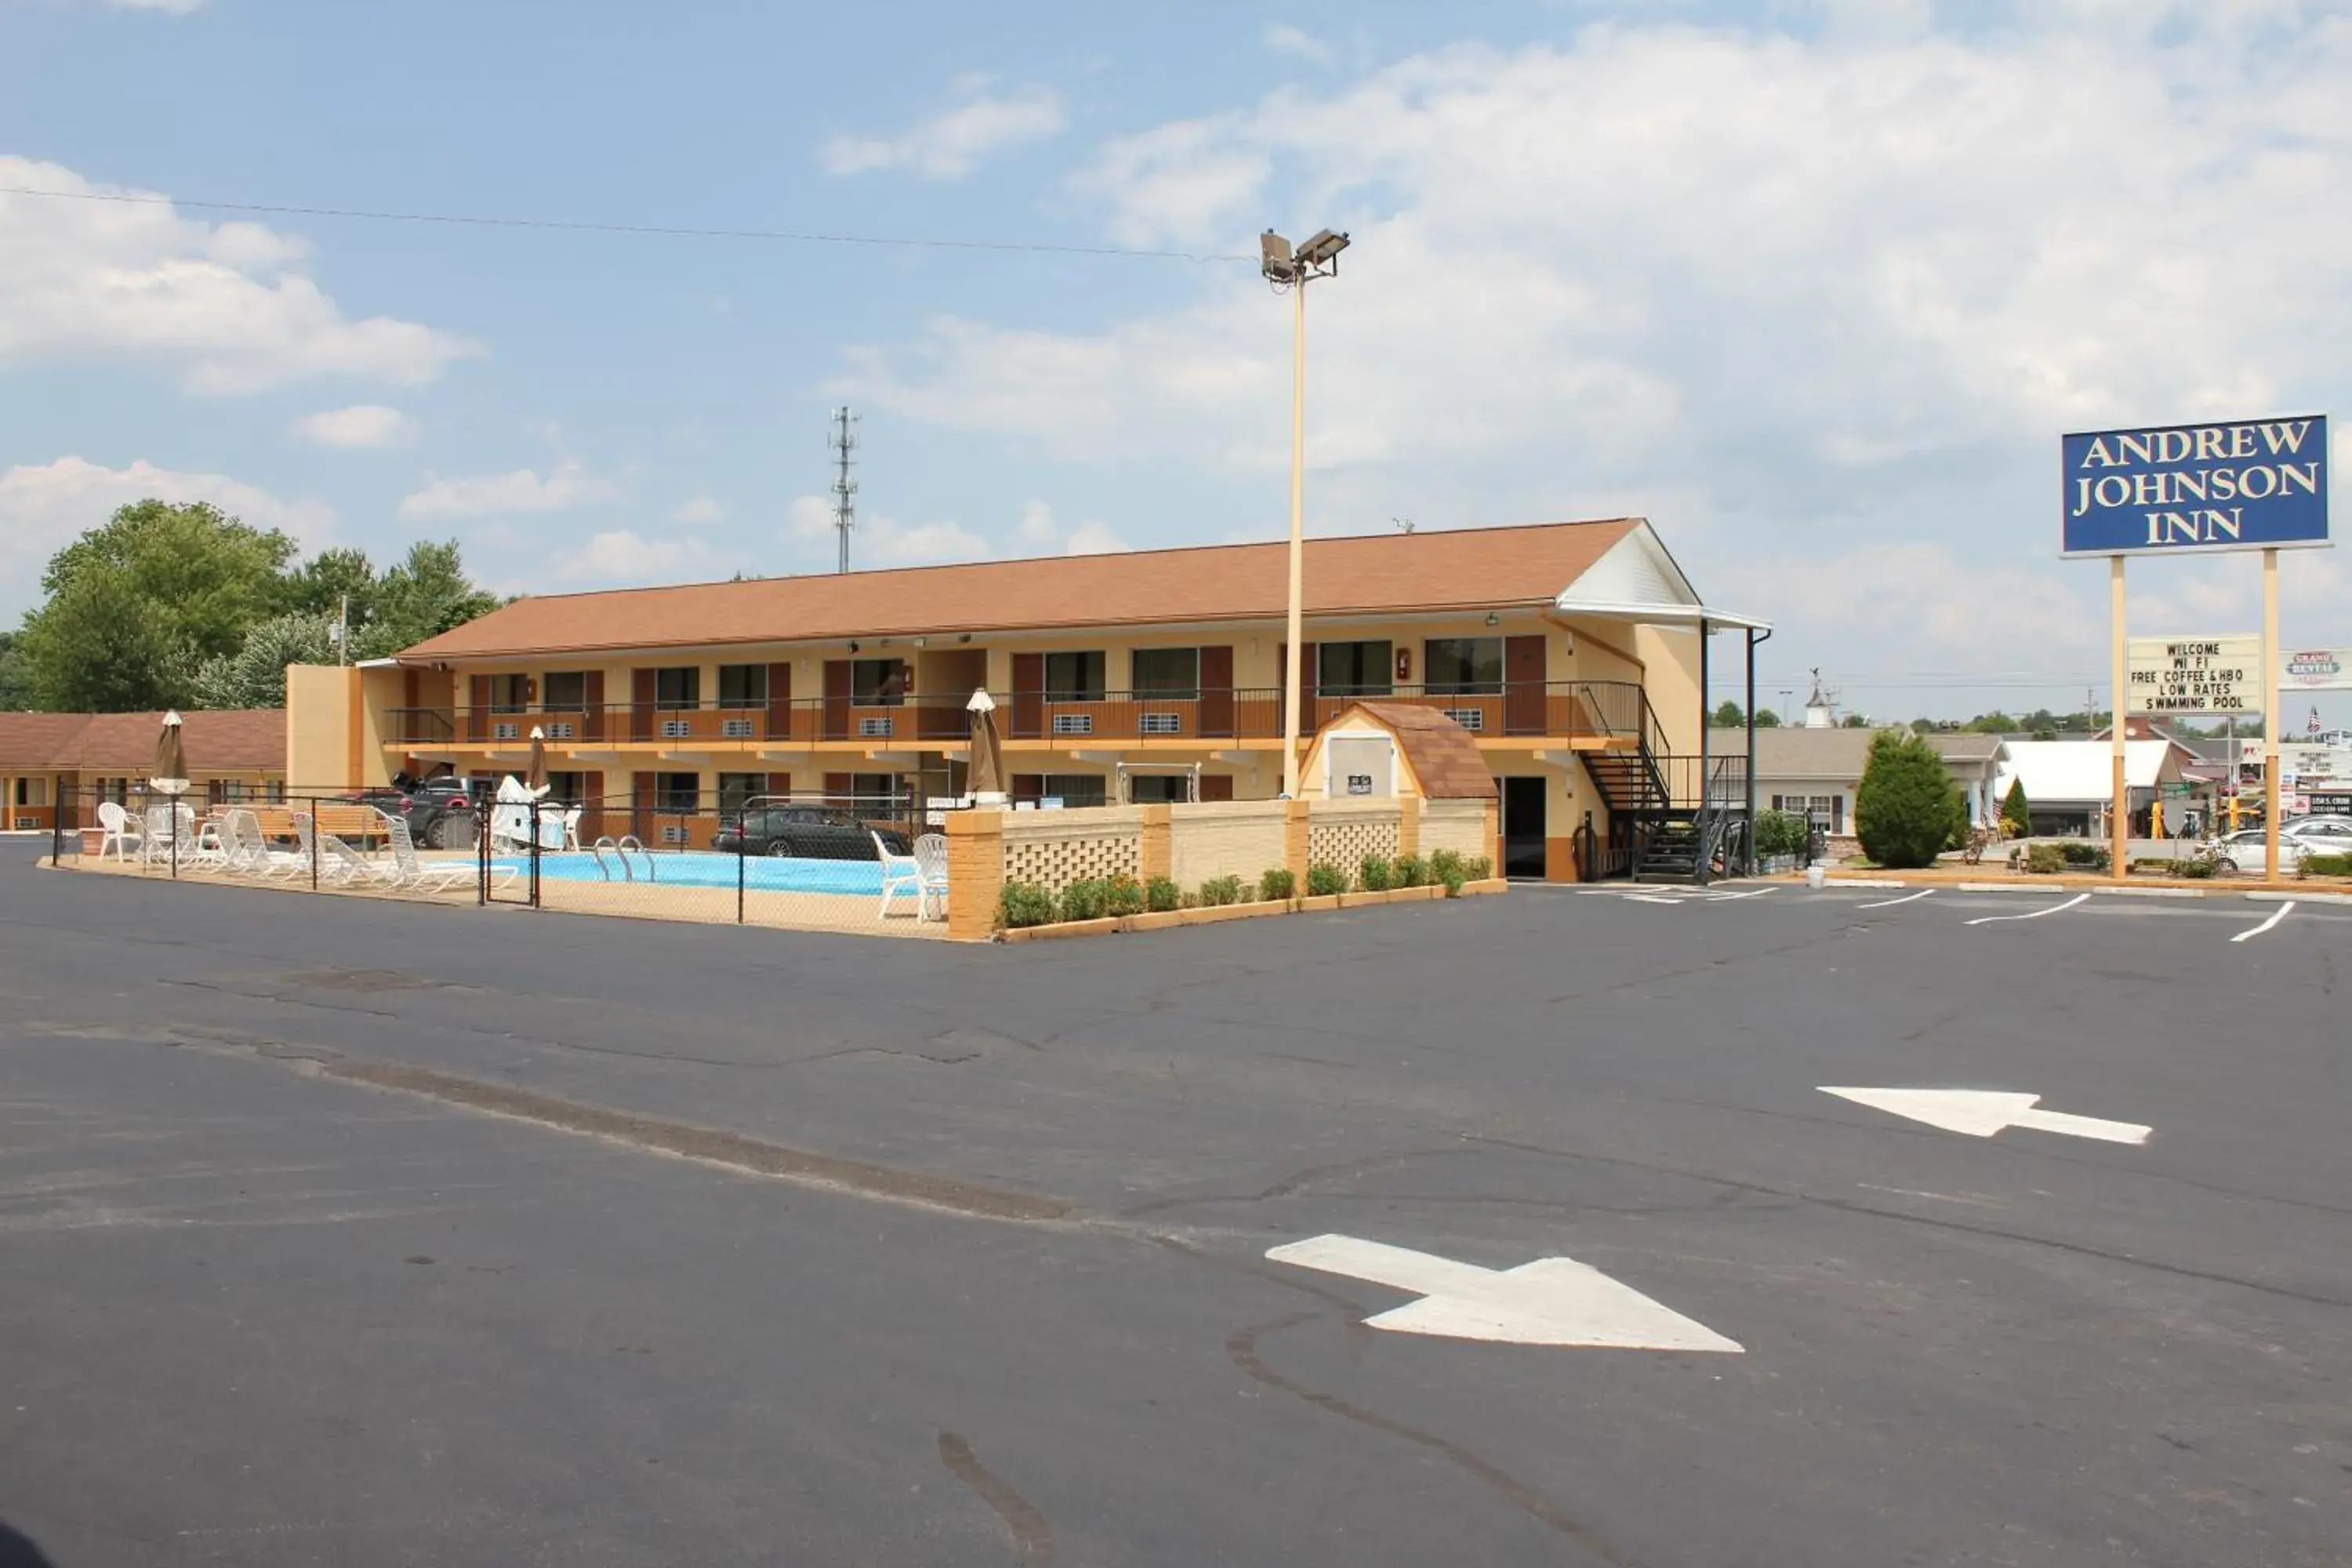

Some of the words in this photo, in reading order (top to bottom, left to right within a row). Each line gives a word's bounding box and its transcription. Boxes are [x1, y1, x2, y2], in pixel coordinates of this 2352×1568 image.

[2080, 419, 2312, 469] ANDREW
[2072, 462, 2320, 517] JOHNSON
[2145, 507, 2244, 544] INN
[2167, 644, 2220, 656] WELCOME
[2132, 672, 2156, 683] FREE
[2165, 670, 2204, 682] COFFEE
[2209, 670, 2216, 681] &
[2160, 684, 2186, 695] LOW
[2194, 683, 2230, 695] RATES
[2146, 697, 2205, 710] SWIMMING
[2213, 696, 2243, 709] POOL
